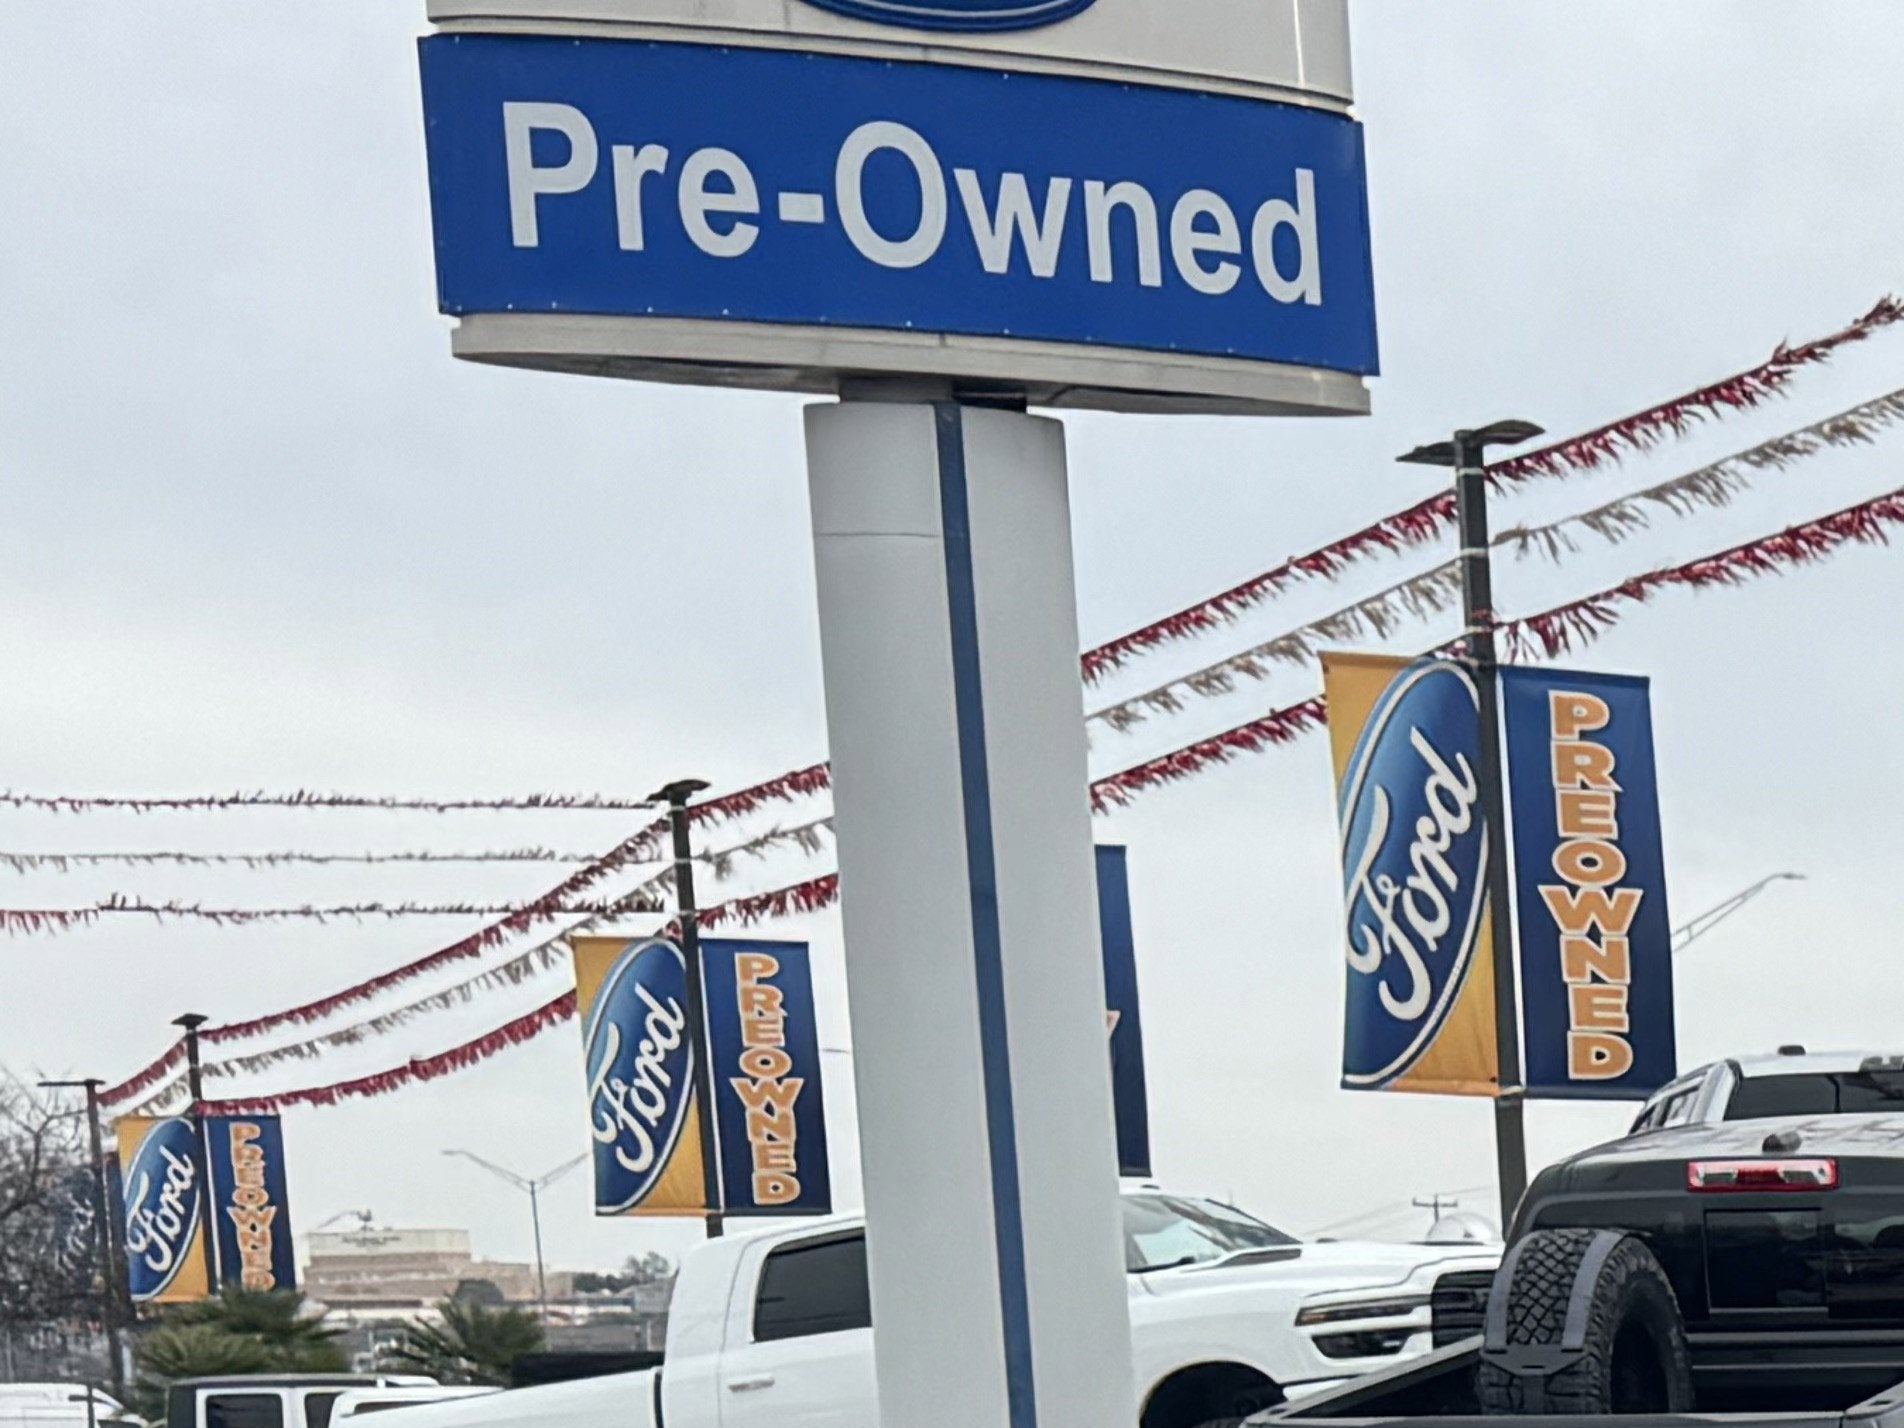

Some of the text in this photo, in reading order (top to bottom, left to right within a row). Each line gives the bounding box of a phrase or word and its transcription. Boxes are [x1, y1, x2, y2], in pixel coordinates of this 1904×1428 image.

[501, 100, 1325, 308] Pre-Owned
[1345, 726, 1478, 1022] Ford
[1537, 689, 1643, 1080] PREOWNED
[590, 982, 686, 1173] Ford
[729, 952, 805, 1205] PREOWNED
[126, 1144, 195, 1273] Ford
